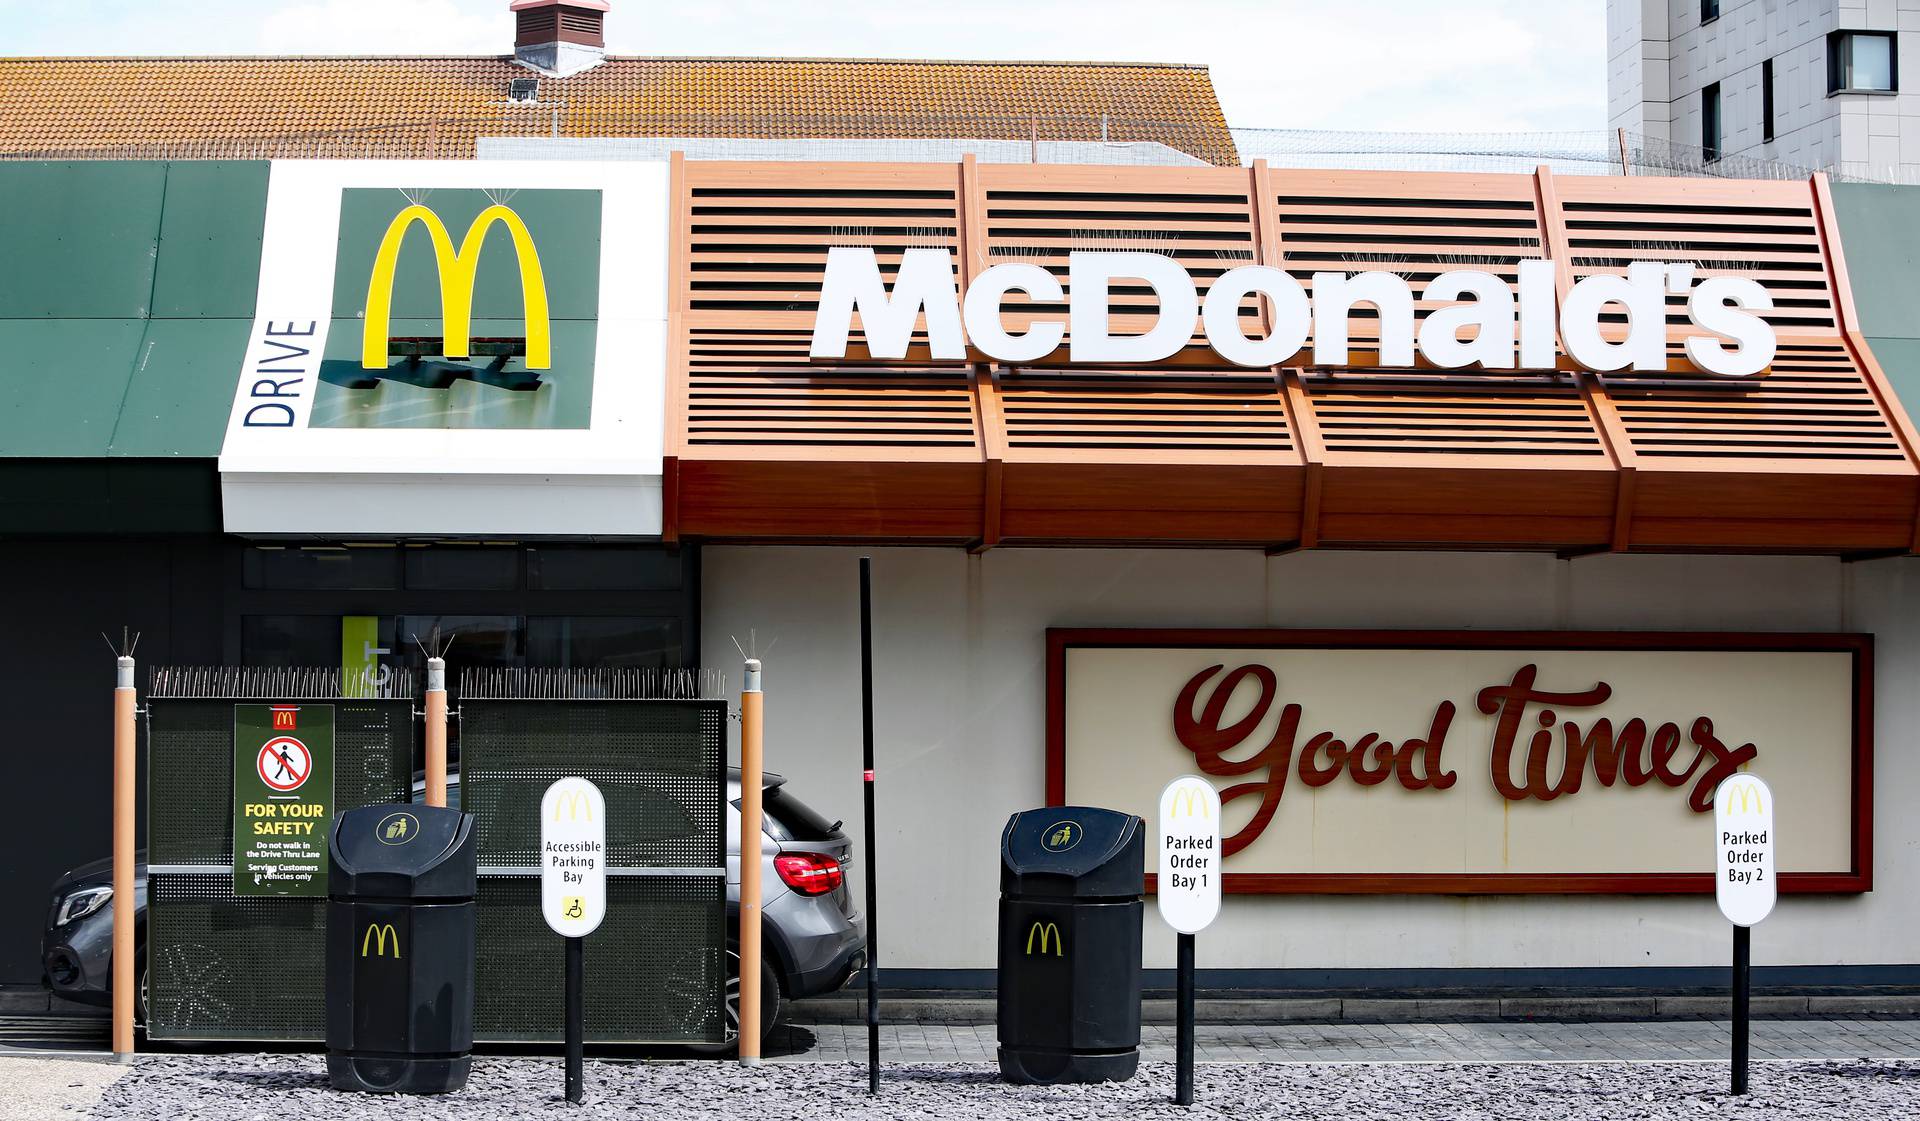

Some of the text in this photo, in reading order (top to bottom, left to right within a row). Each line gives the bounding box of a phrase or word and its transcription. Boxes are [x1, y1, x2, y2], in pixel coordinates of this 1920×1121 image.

[809, 246, 1777, 377] McDonald's
[243, 321, 317, 427] DRIVE
[1173, 663, 1457, 859] Good
[245, 804, 324, 817] FOR YOUR
[253, 821, 315, 835] SAFETY
[1166, 835, 1213, 849] Parked
[1723, 830, 1767, 845] Parked
[283, 841, 301, 849] walk
[303, 841, 311, 849] in
[545, 841, 601, 852] Accessible
[246, 850, 260, 858] the
[260, 850, 282, 858] Drive
[282, 850, 300, 858] Thru
[1727, 849, 1763, 864] Order
[248, 863, 318, 872] Serving Customers
[552, 856, 594, 870] Parking
[1170, 854, 1209, 869] Order
[254, 872, 312, 881] in vehicles only
[563, 871, 583, 884] Bay
[1172, 873, 1207, 890] Bay 1
[1729, 868, 1763, 885] Bay 2
